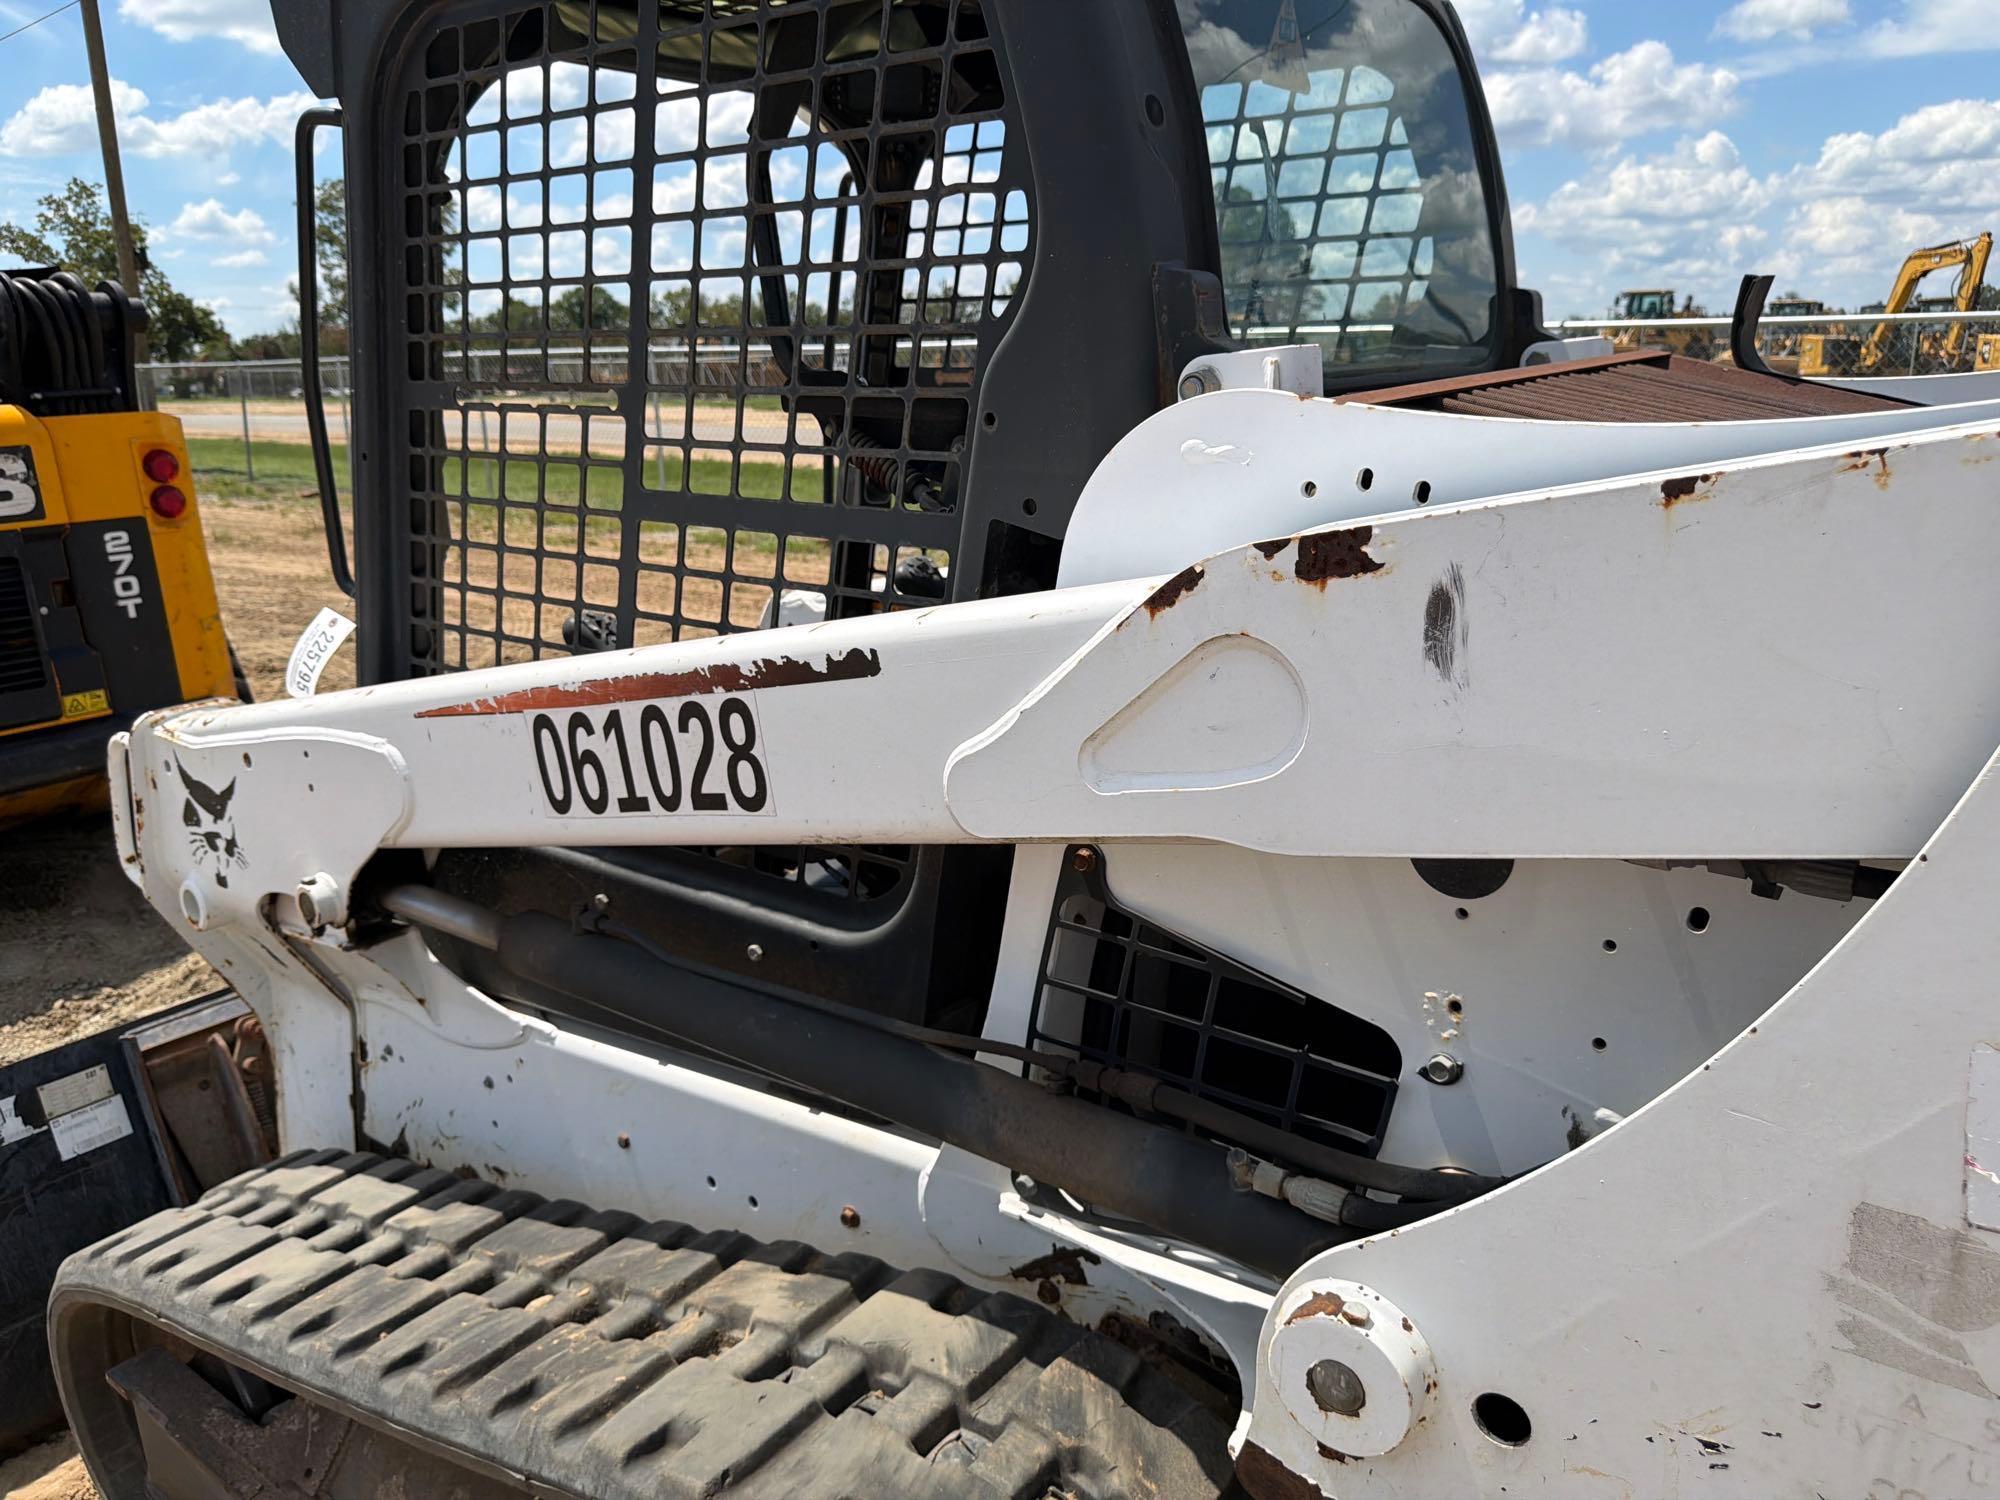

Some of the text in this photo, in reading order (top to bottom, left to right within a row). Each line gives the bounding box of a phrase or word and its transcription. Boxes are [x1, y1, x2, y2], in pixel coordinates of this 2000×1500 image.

[103, 530, 143, 619] 270T
[296, 630, 335, 694] 225795
[532, 697, 768, 815] 061028
